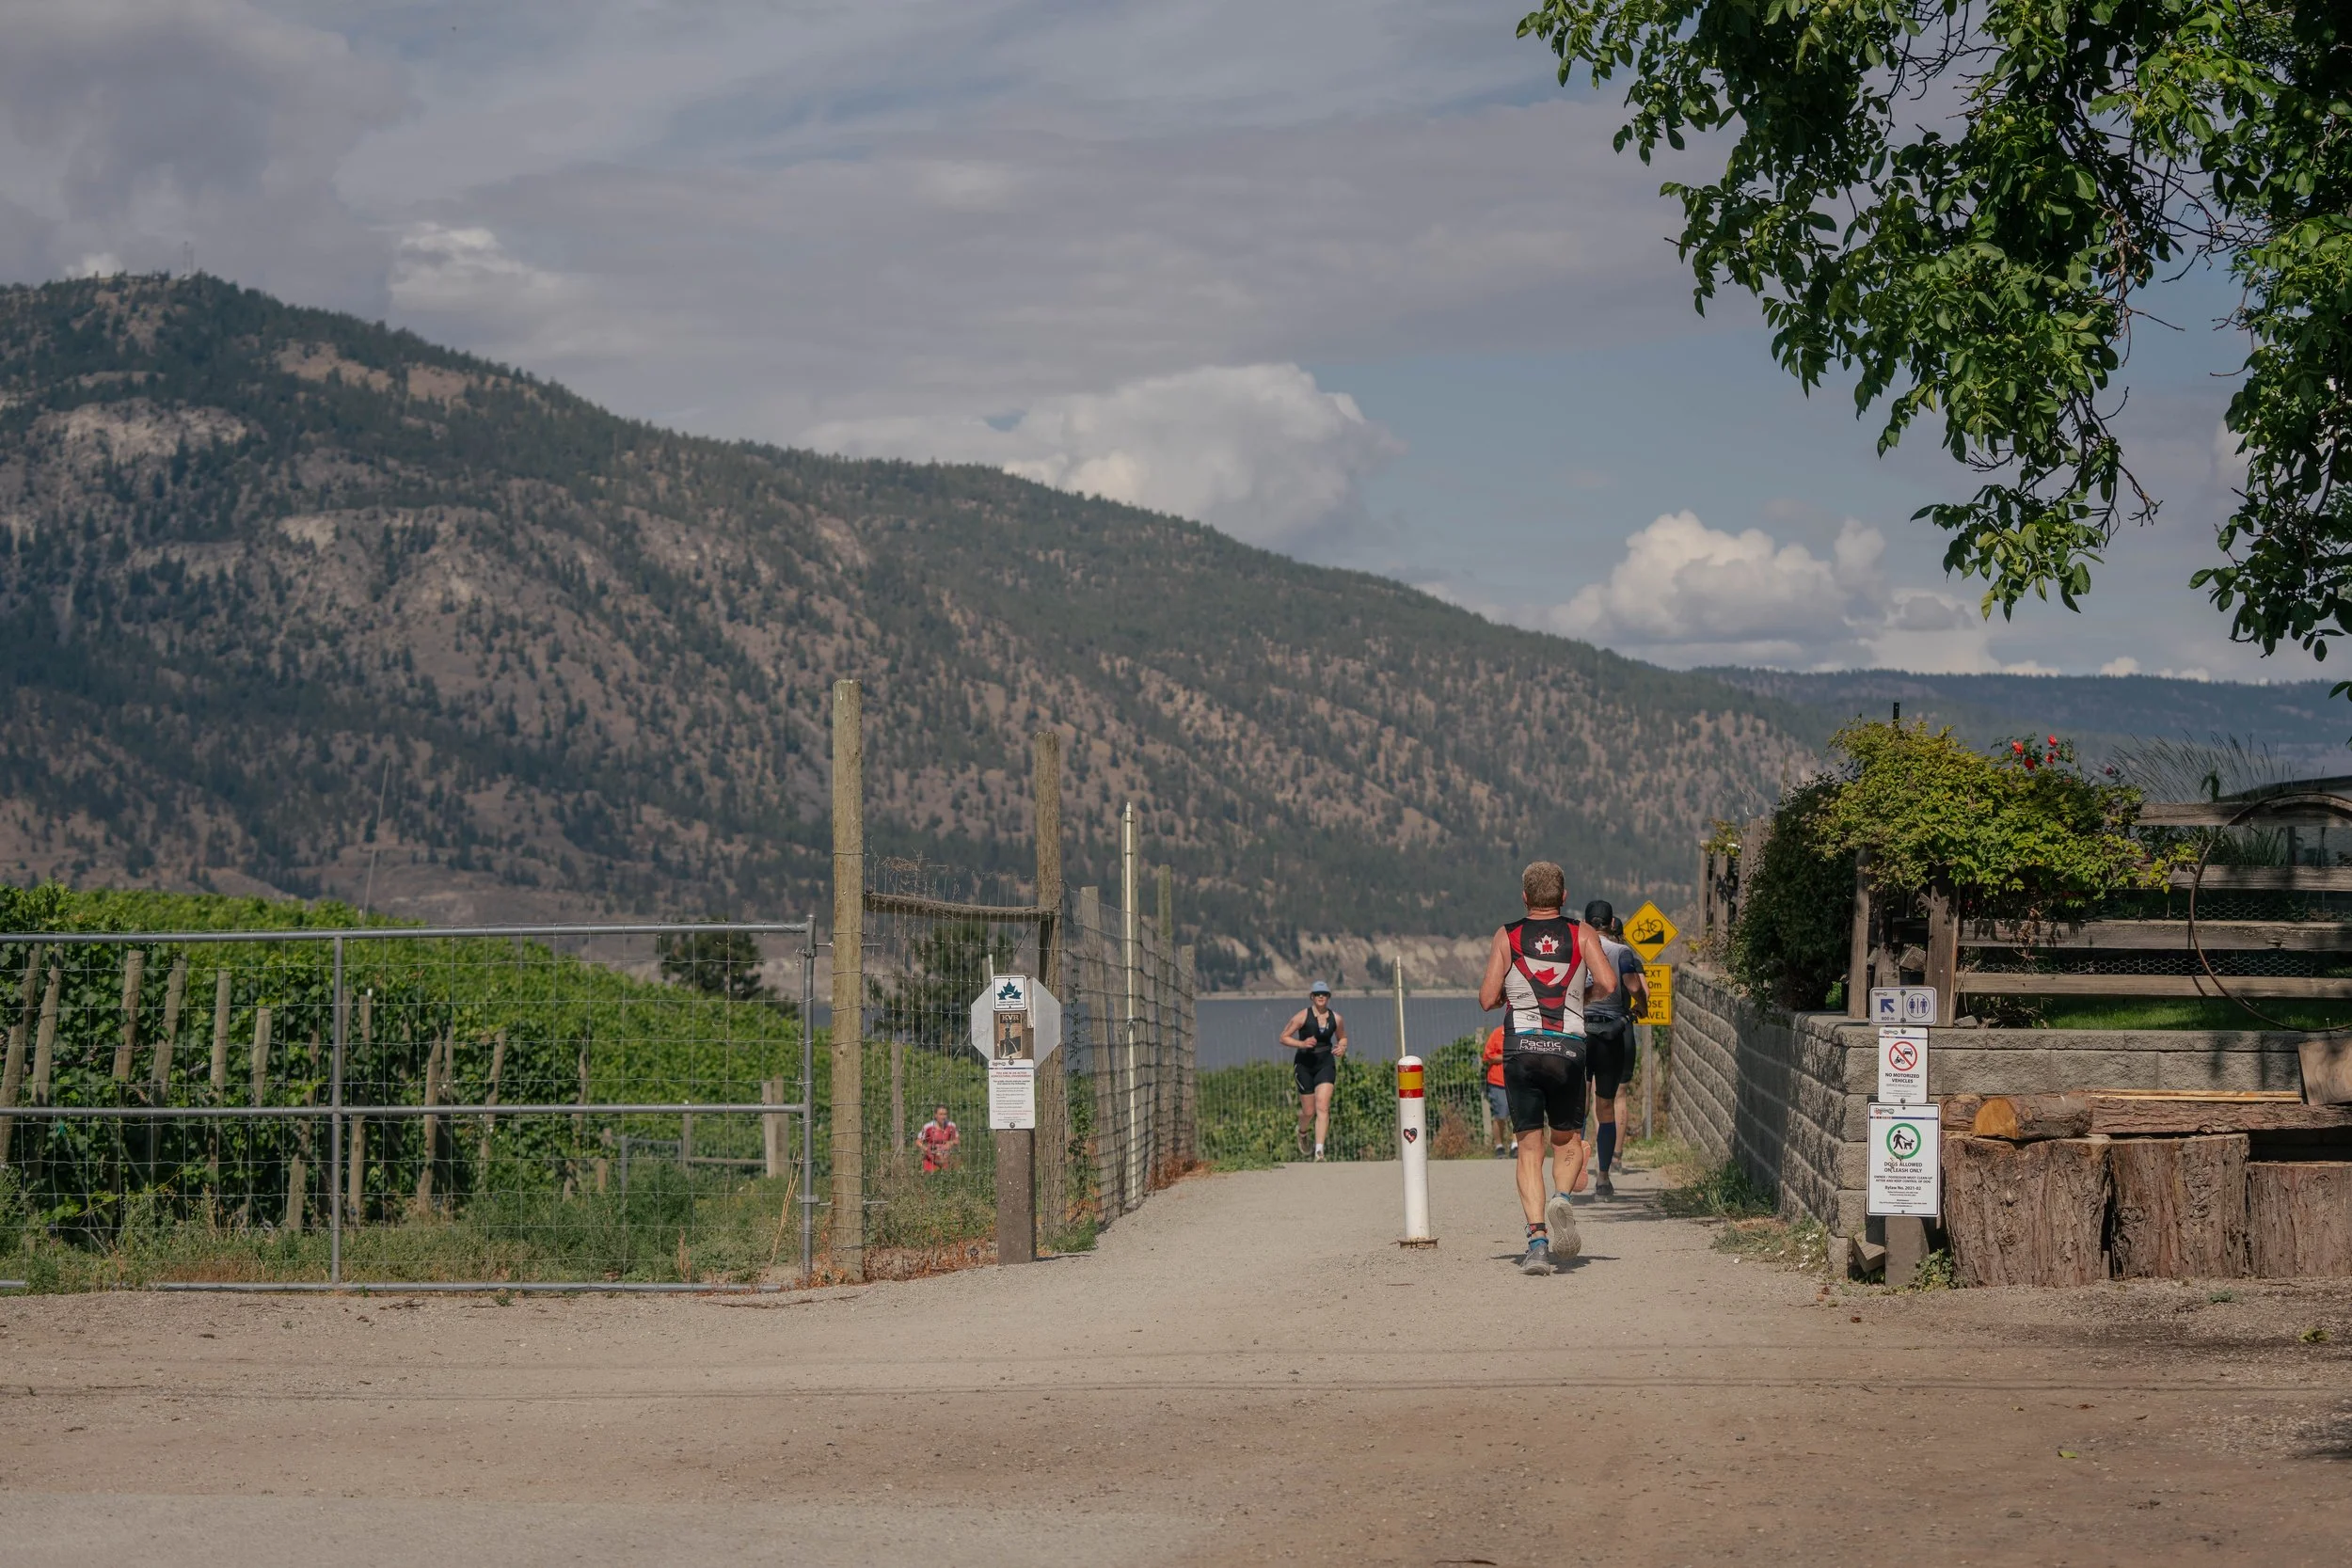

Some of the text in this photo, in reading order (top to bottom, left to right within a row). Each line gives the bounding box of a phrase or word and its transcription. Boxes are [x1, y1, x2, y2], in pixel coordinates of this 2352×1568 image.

[1645, 970, 1661, 978] EXT
[1647, 980, 1662, 989] 0m
[1646, 1000, 1663, 1008] OSE
[1647, 1011, 1666, 1020] VEL
[1519, 1038, 1562, 1048] Pacific
